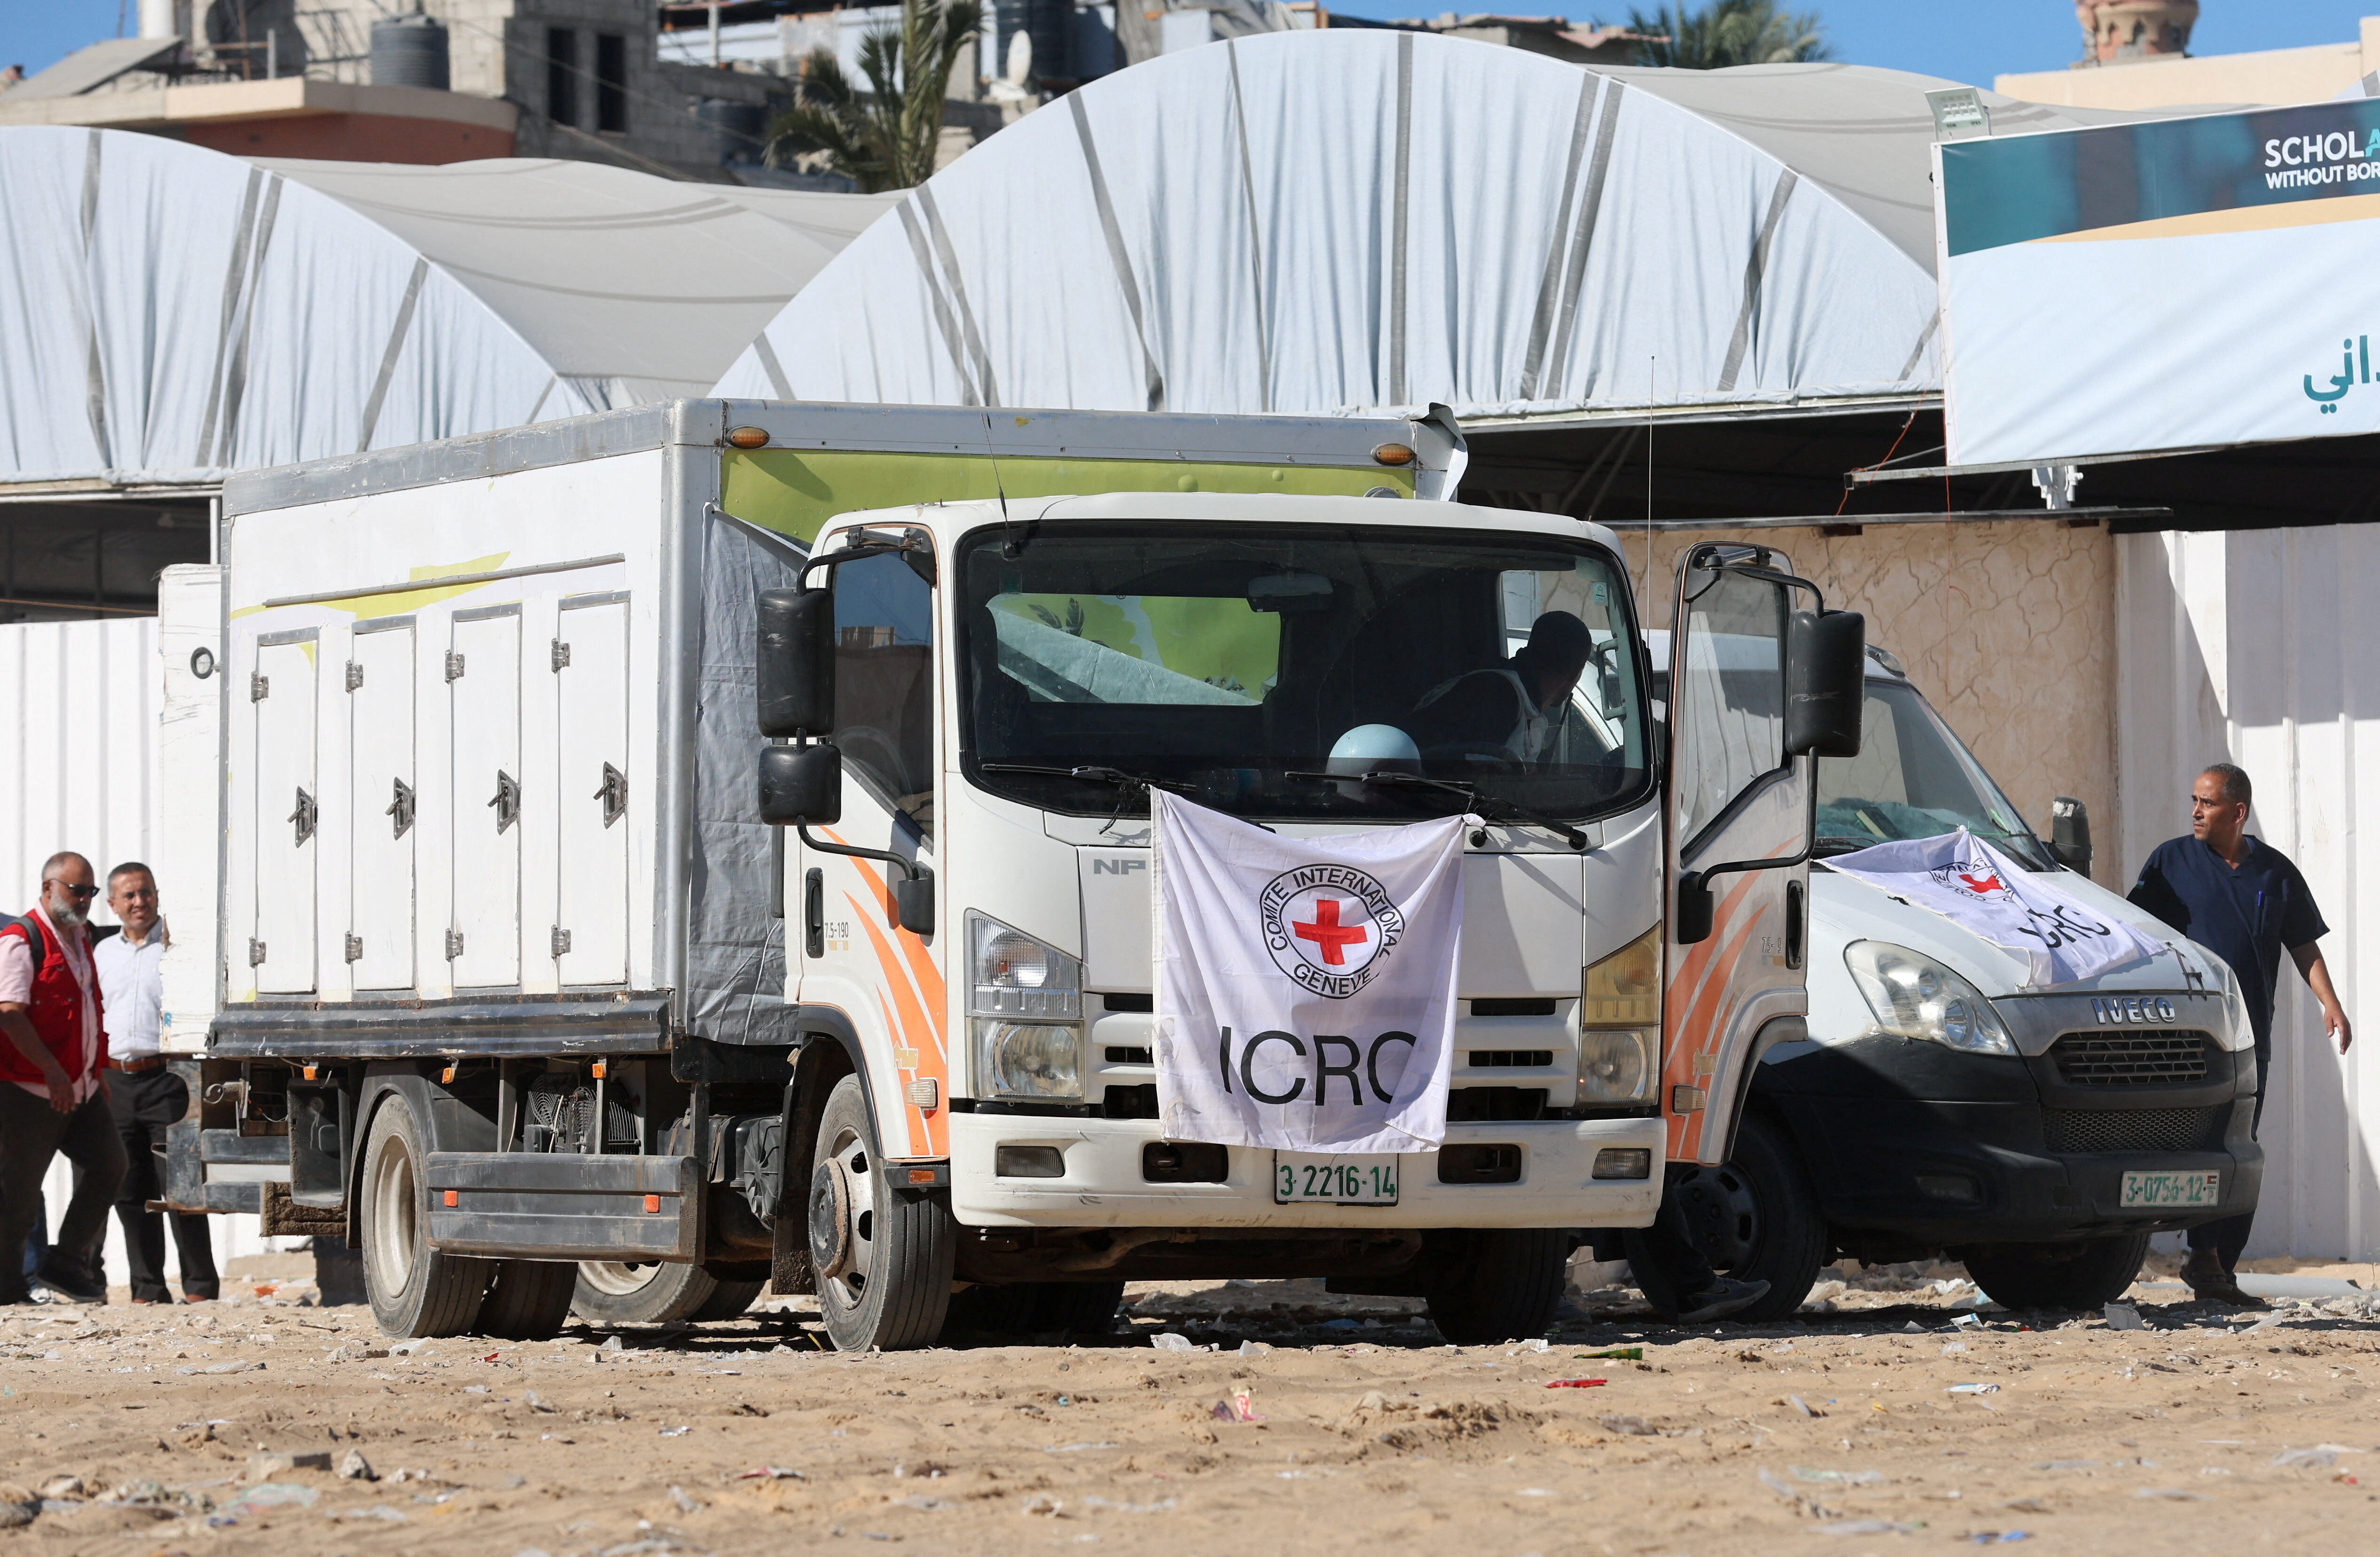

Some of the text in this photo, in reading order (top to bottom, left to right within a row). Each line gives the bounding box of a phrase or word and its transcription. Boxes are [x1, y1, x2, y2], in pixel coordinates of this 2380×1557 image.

[2265, 165, 2344, 189] WITHOUT
[1262, 868, 1401, 958] COMITE INTERNATIONAL
[824, 922, 849, 938] 7.5-190
[1293, 963, 1371, 995] GENEVE
[2091, 997, 2176, 1024] IVECO
[1220, 1026, 1417, 1106] ICRC
